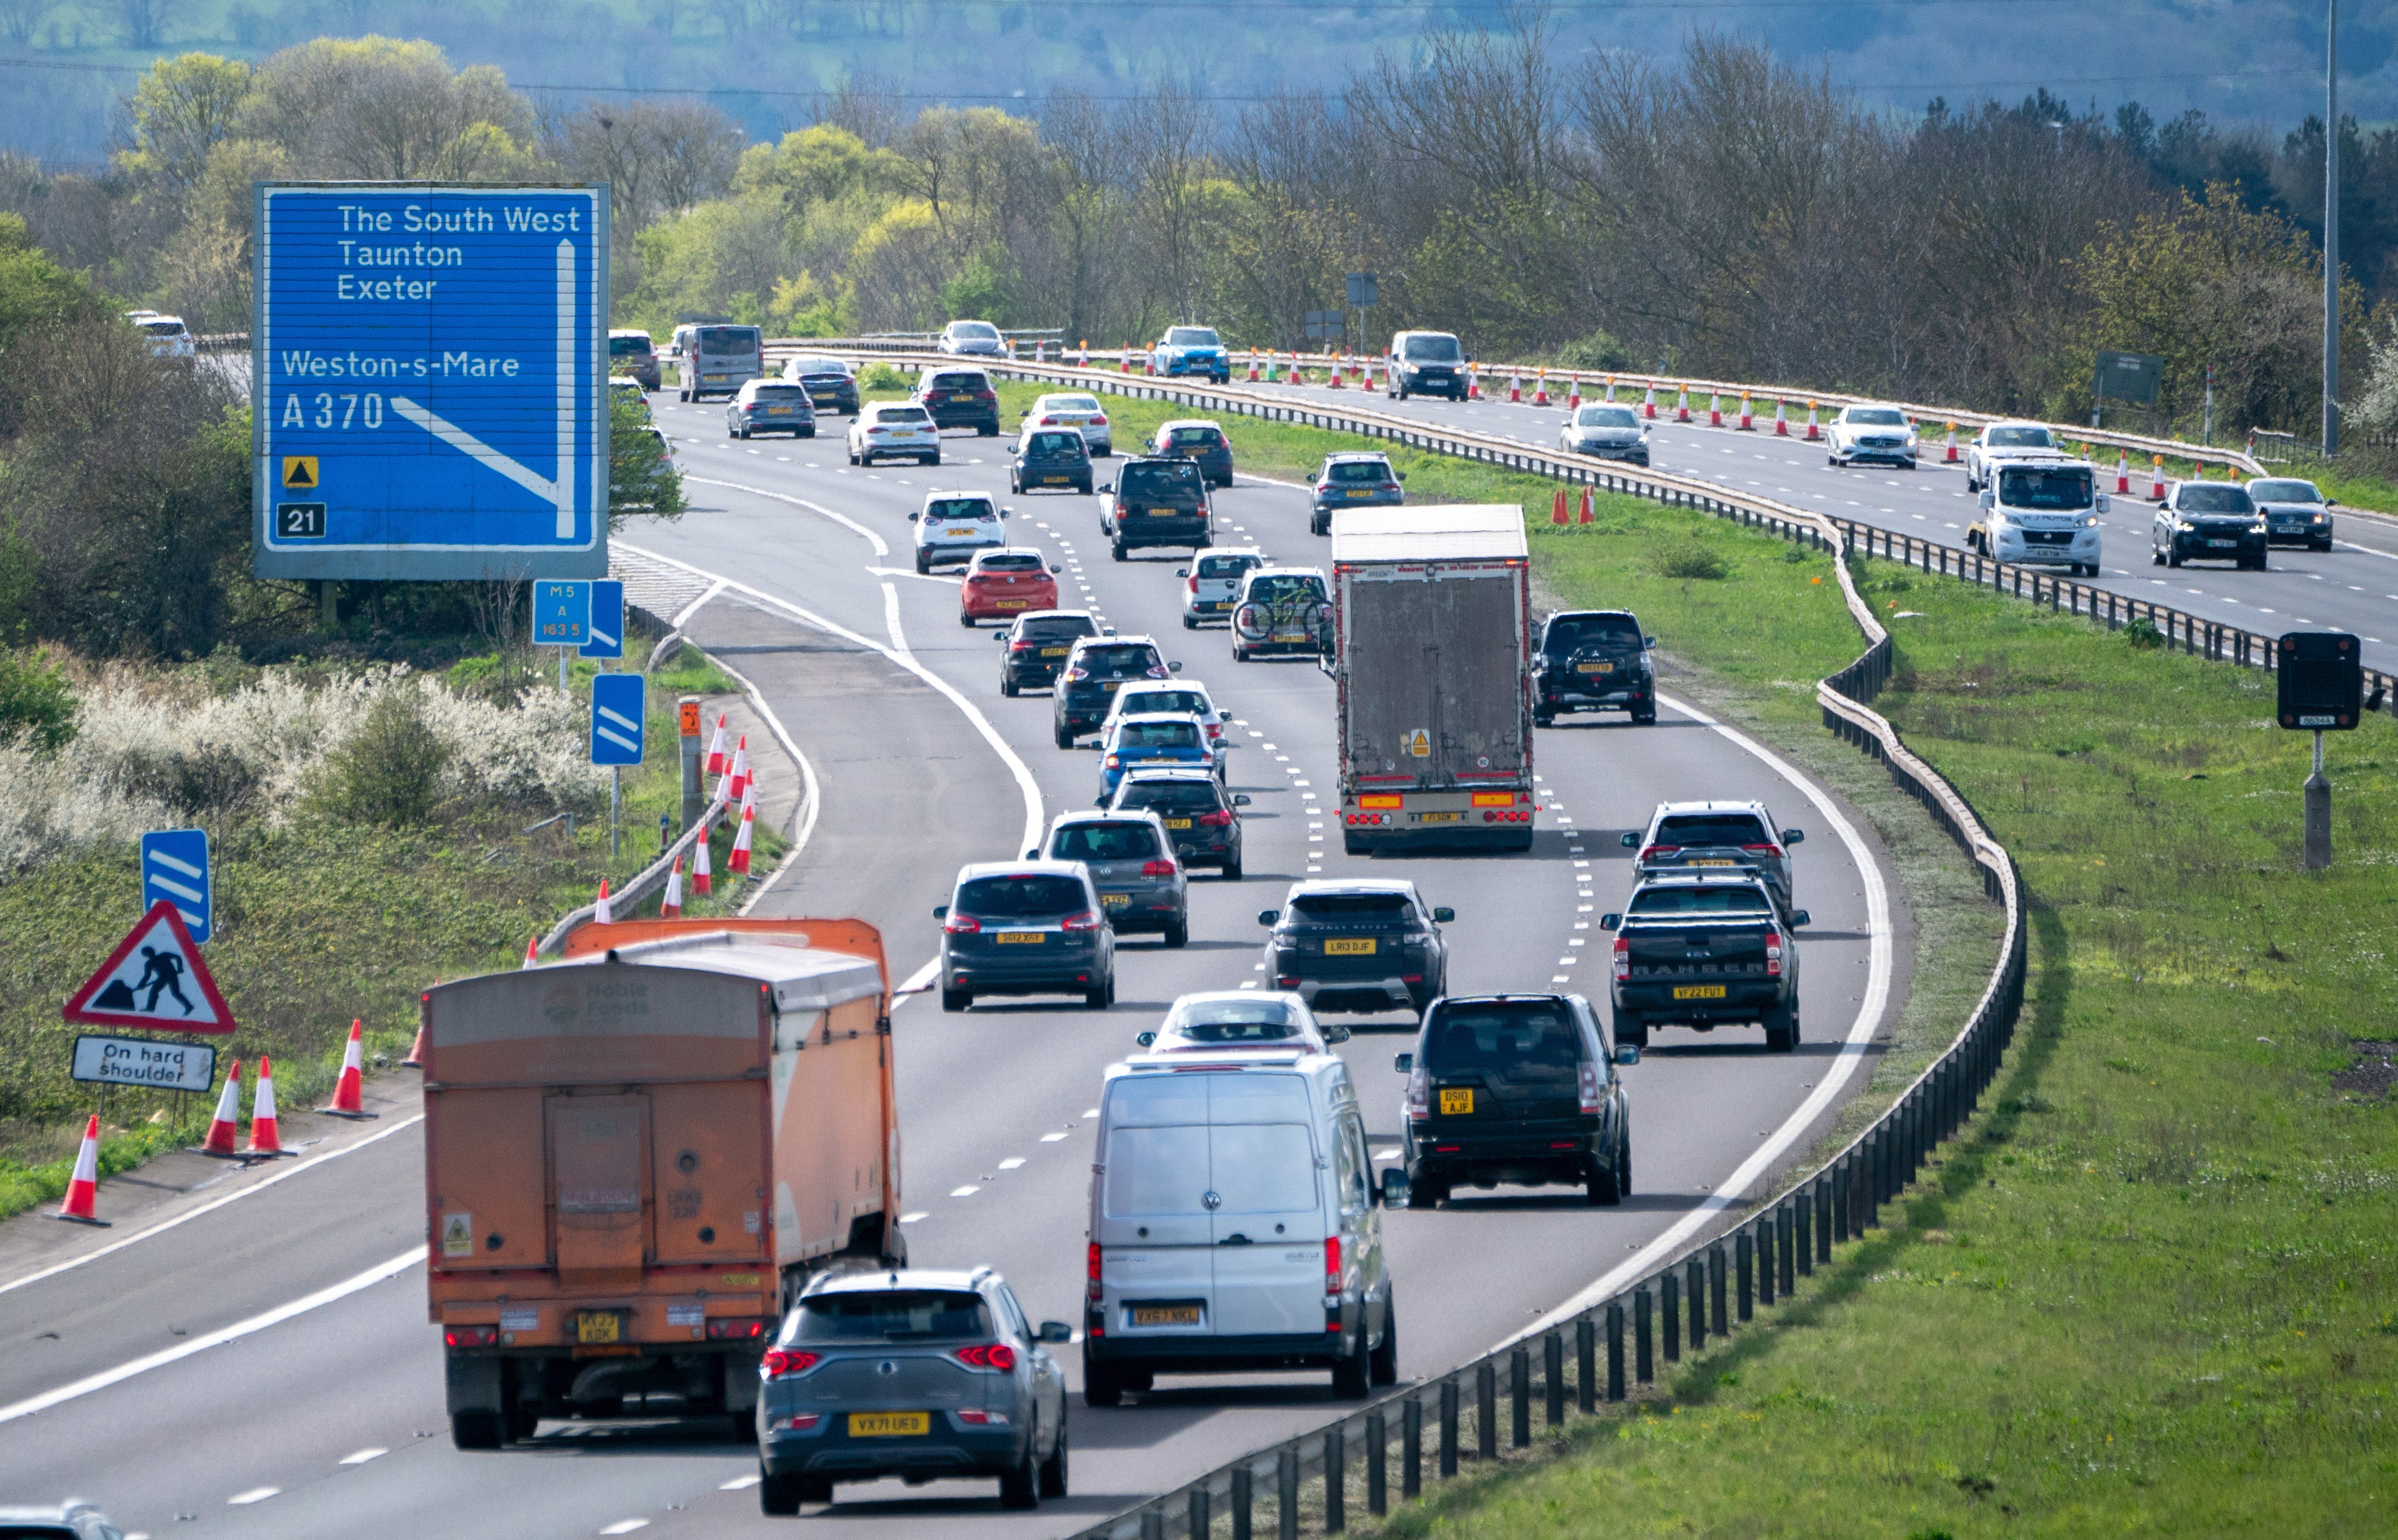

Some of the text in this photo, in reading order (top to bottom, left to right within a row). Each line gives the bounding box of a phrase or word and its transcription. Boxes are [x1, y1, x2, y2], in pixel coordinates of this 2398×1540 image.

[337, 205, 580, 232] The South West
[337, 240, 463, 267] Taunton
[337, 274, 437, 301] Exeter
[281, 350, 520, 377] Weston-s-Mare
[287, 510, 315, 533] 21
[558, 605, 567, 617] A
[1331, 942, 1370, 952] LR13 DJF
[1633, 962, 1763, 975] RANGER
[1678, 988, 1721, 997] VF22 FUT
[104, 1044, 184, 1064] On hard
[99, 1062, 185, 1083] shoulder
[1445, 1092, 1468, 1102] DS10
[1449, 1102, 1468, 1113] AJF
[1137, 1307, 1196, 1325] VX67 NKL
[858, 1418, 889, 1431] VX71
